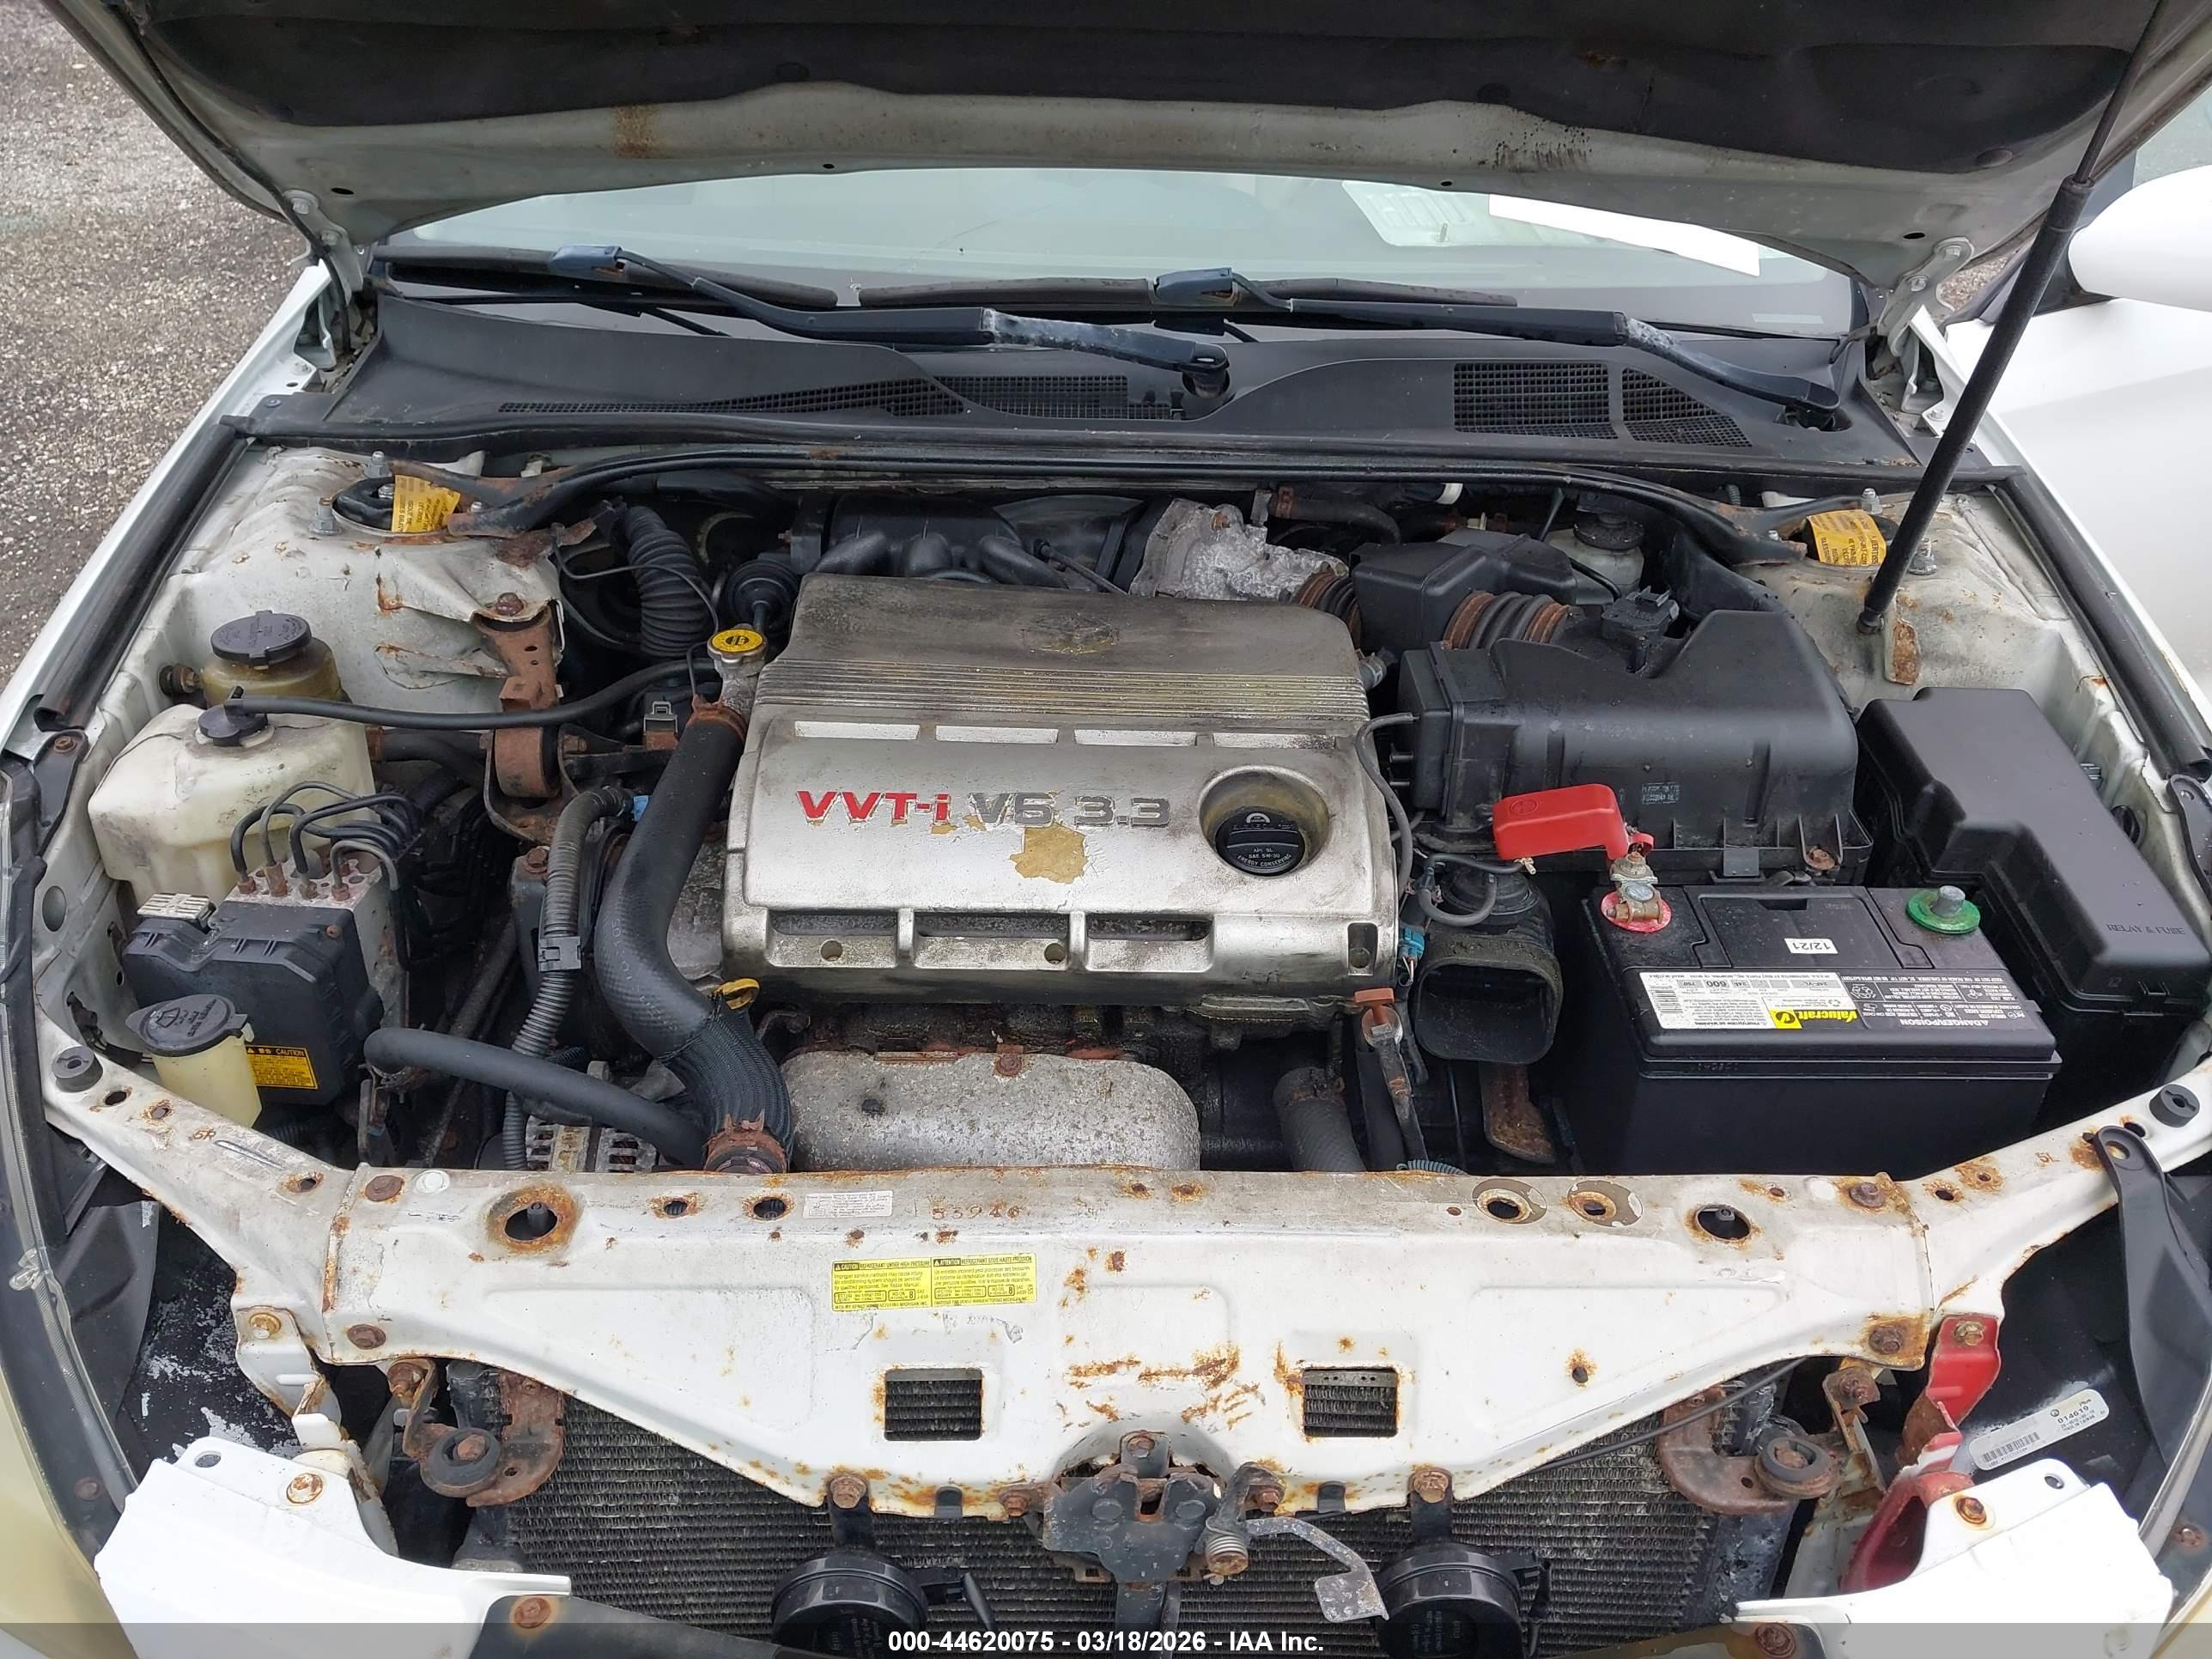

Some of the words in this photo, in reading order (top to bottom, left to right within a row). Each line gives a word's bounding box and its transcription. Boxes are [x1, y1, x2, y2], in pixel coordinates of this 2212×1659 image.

[797, 791, 951, 824] VVT-i
[968, 792, 1056, 826] V6
[1074, 795, 1171, 827] 3.3
[2106, 924, 2142, 933] RELAY
[1793, 942, 1831, 950] 12/21
[1009, 1286, 1012, 1294] 8
[2057, 1406, 2089, 1424] 014619
